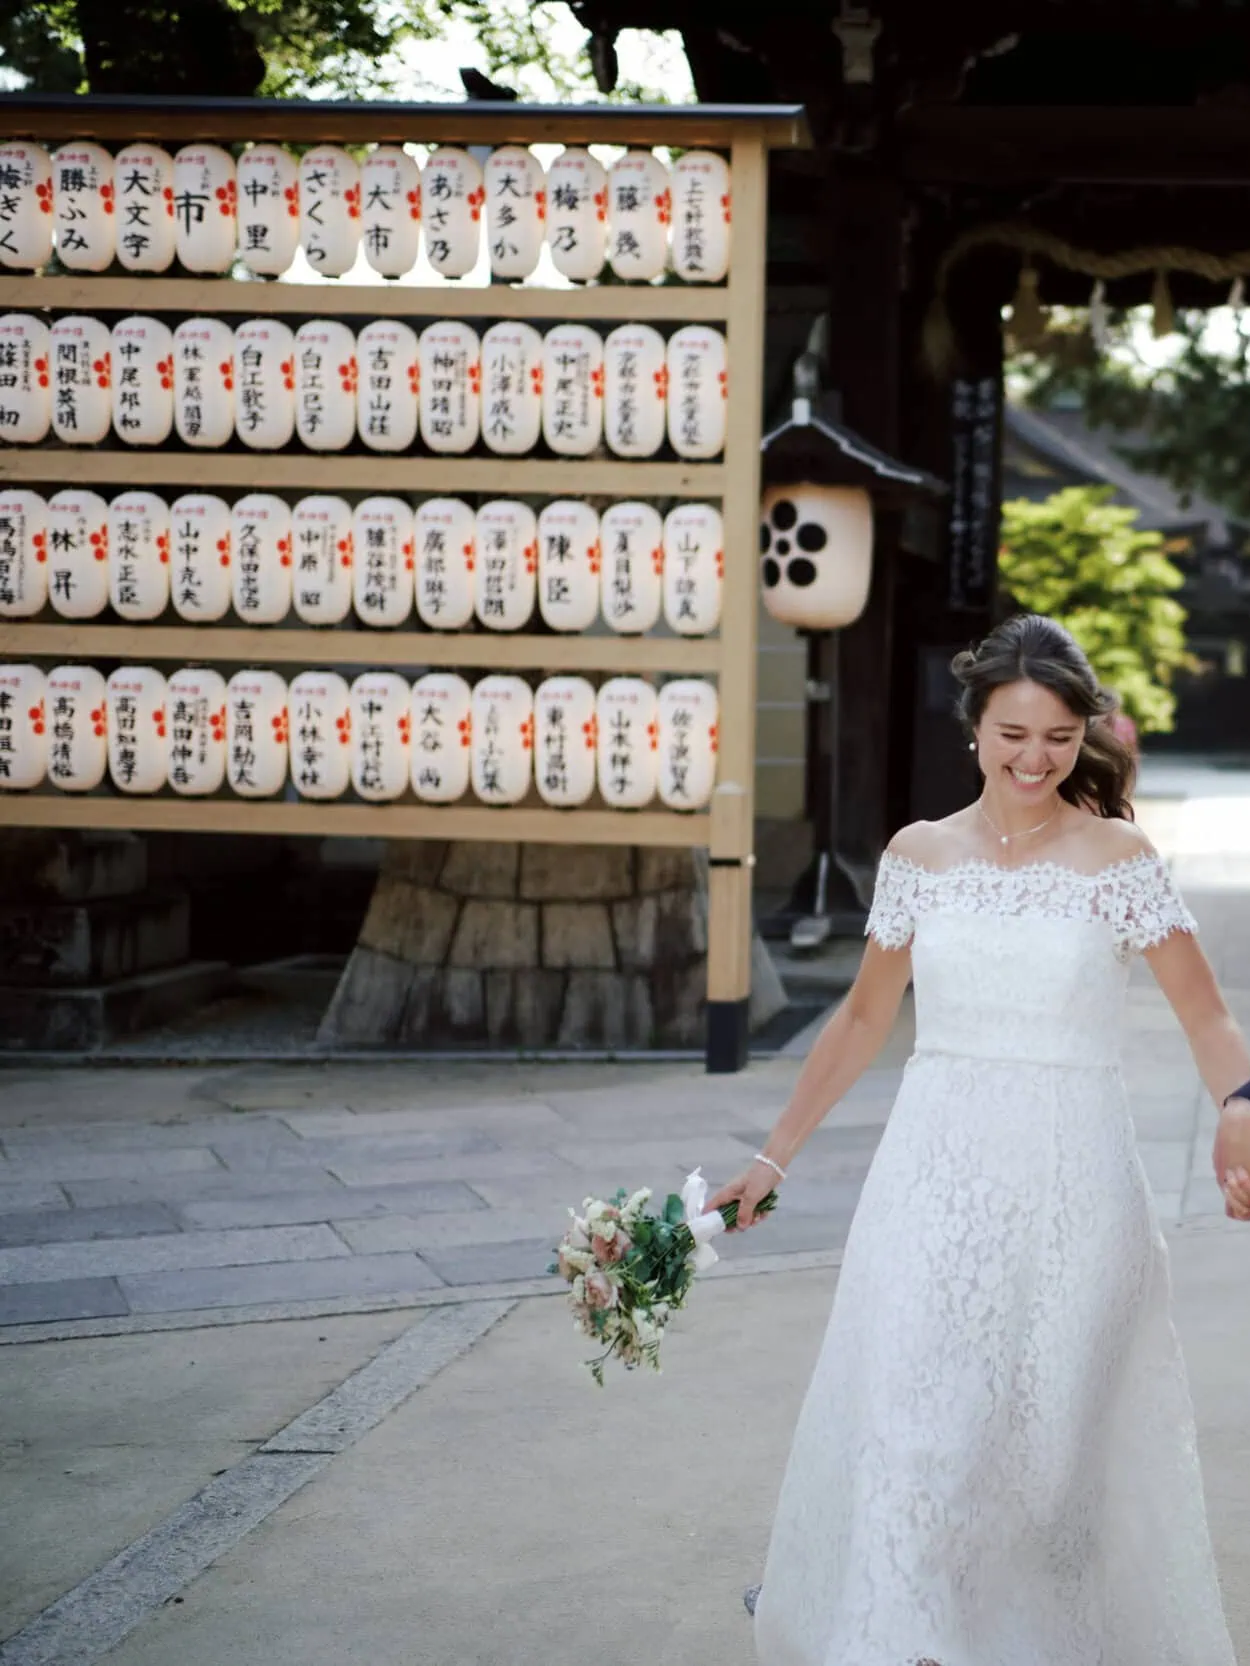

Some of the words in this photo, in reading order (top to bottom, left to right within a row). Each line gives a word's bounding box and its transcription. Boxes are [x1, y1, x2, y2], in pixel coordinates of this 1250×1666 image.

[59, 169, 88, 251] 勝ふみ
[122, 170, 152, 259] 大文字
[175, 191, 210, 236] 市
[243, 179, 271, 252] 中里
[305, 169, 327, 261] さくら
[364, 185, 393, 257] 大市
